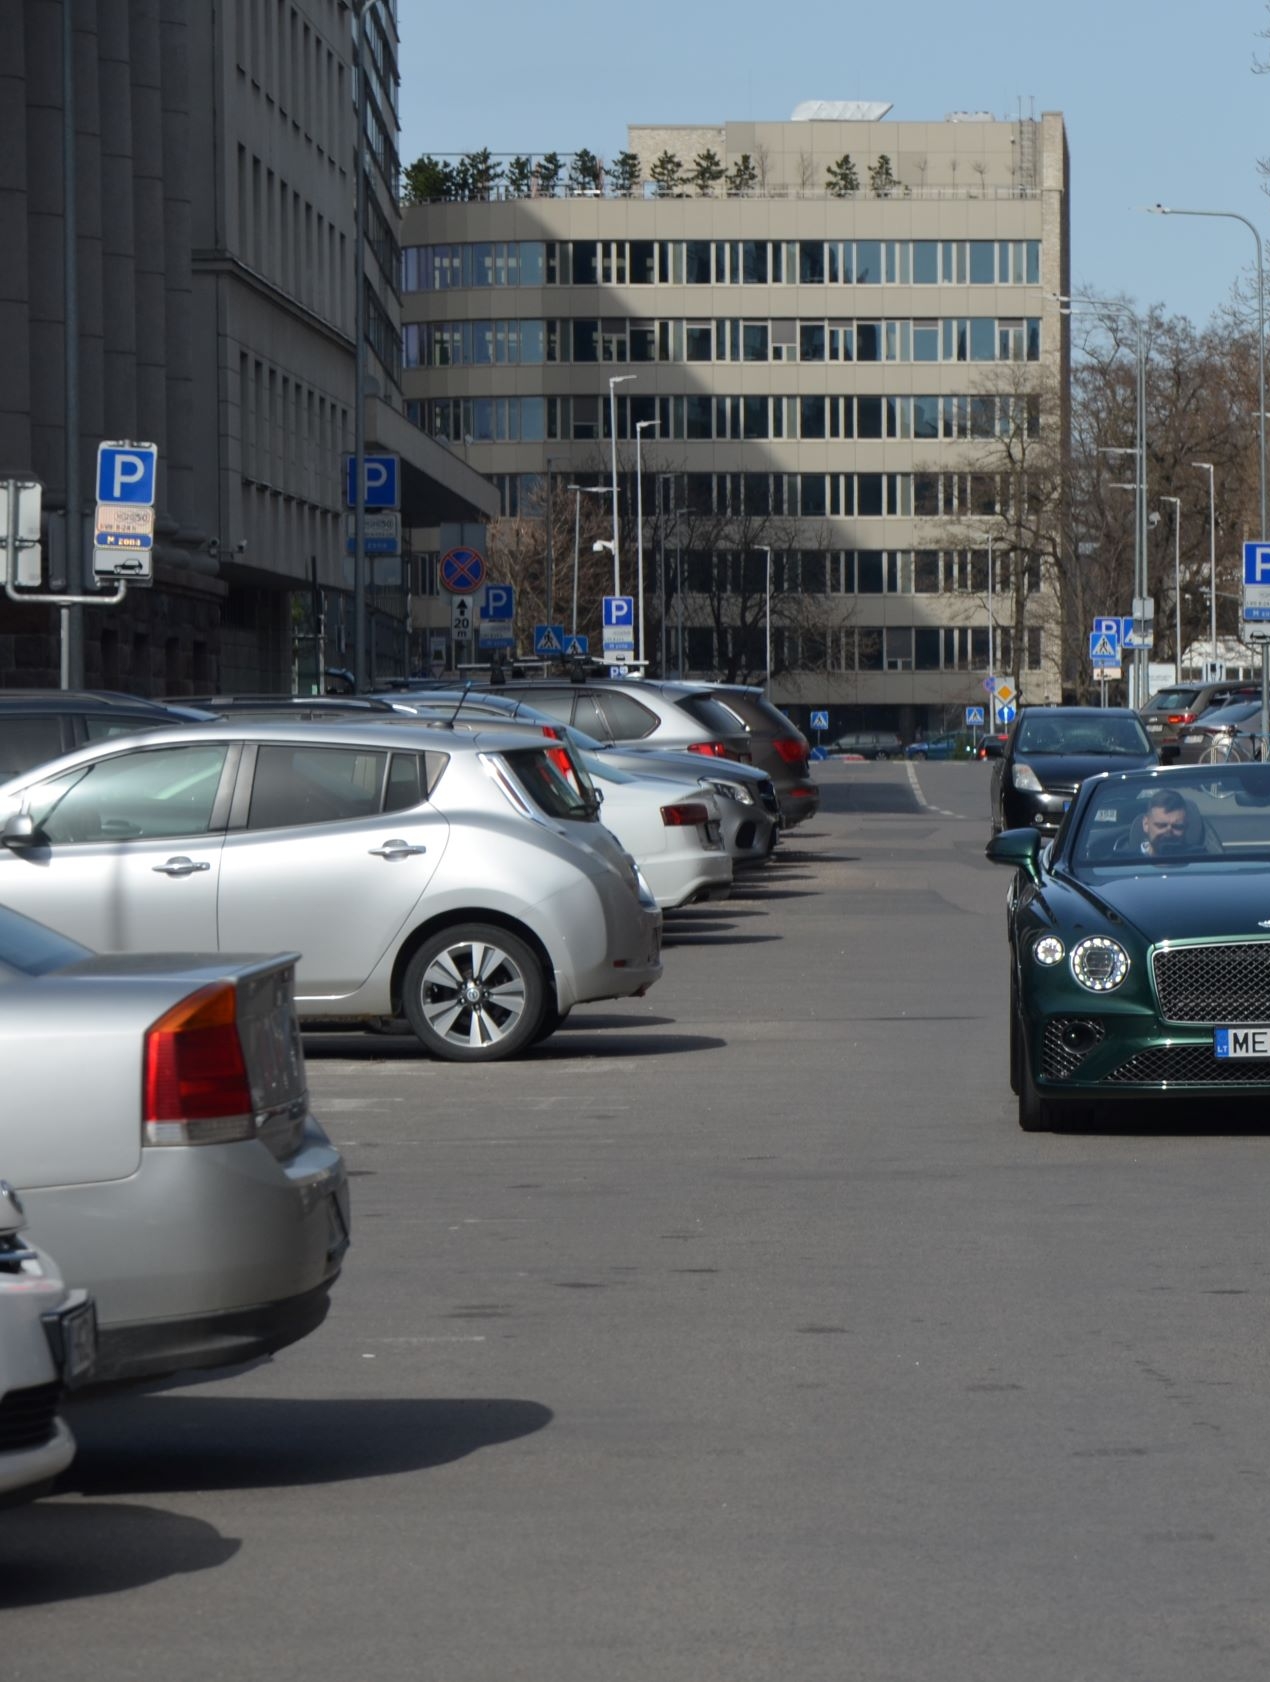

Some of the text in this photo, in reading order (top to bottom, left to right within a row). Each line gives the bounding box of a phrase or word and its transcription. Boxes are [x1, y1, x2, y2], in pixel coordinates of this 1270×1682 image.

[113, 454, 145, 498] P
[364, 463, 388, 501] P
[107, 535, 115, 545] M
[489, 589, 507, 616] P
[611, 600, 628, 624] P
[454, 618, 469, 629] 20
[1217, 1045, 1228, 1053] LT
